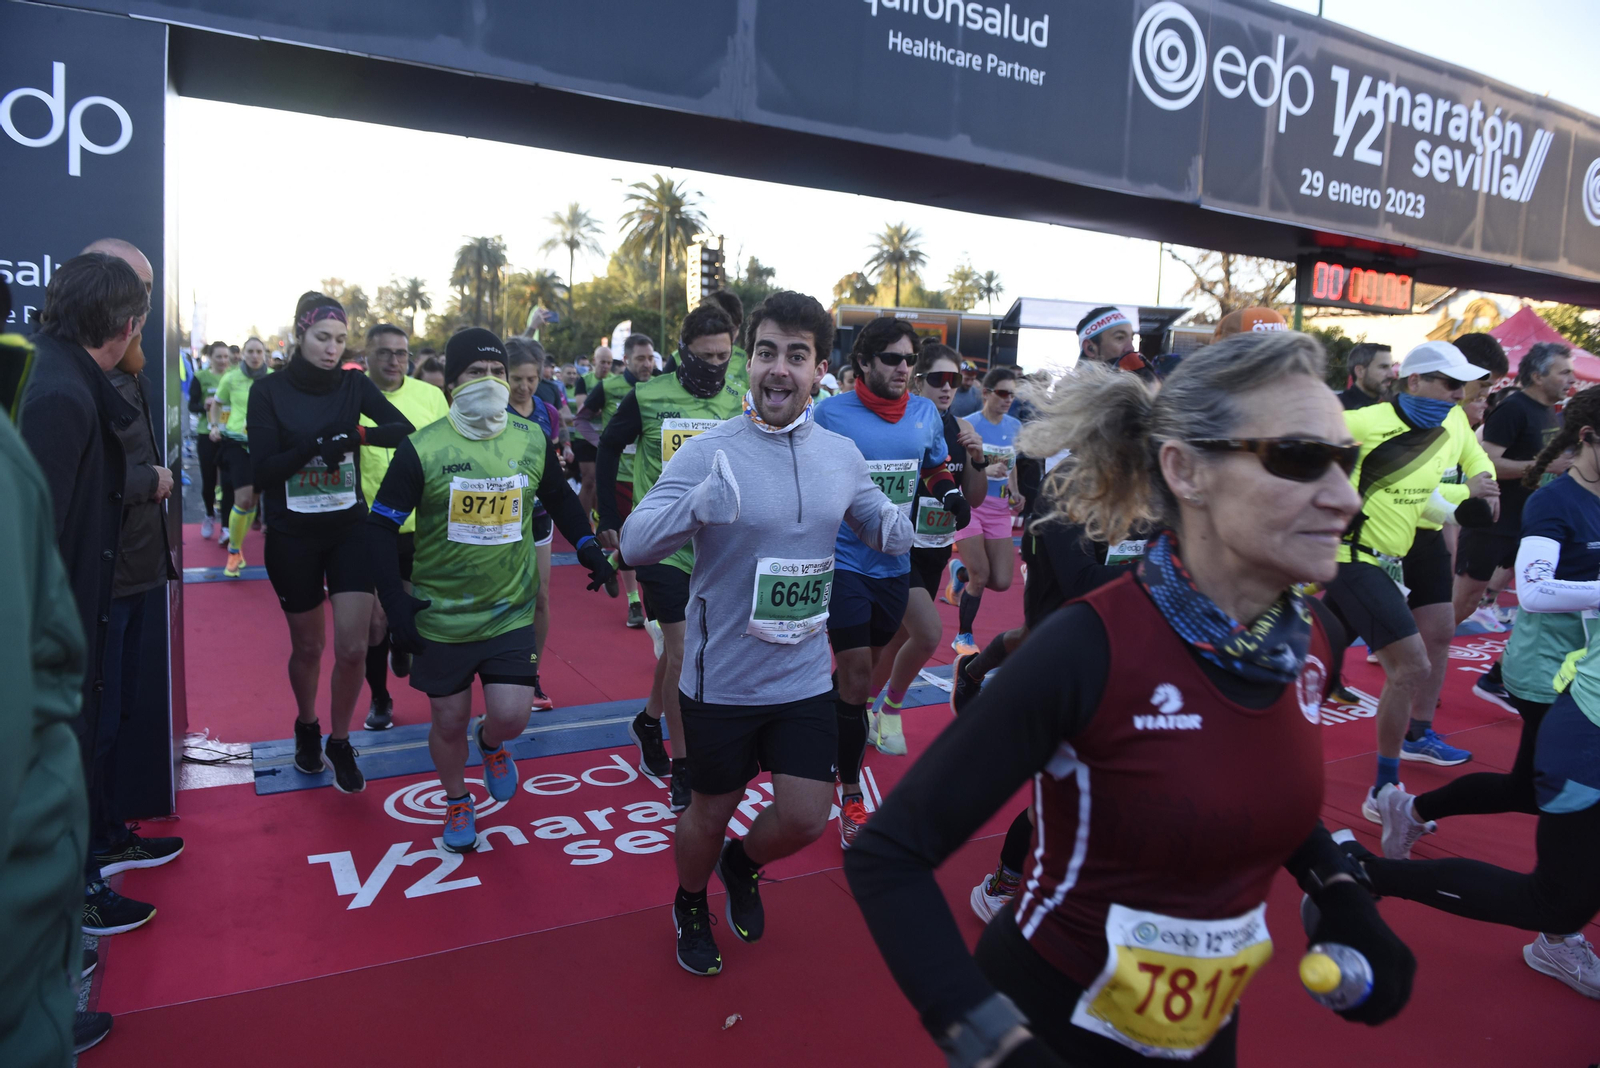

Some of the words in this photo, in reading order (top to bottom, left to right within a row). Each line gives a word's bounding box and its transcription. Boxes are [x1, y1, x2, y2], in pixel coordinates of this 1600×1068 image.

[888, 29, 982, 71] Healthcare
[986, 53, 1046, 86] Partner
[1212, 34, 1315, 133] edp
[1377, 79, 1523, 159] maratón
[1412, 139, 1522, 201] sevilla
[1300, 168, 1325, 197] 29
[1328, 178, 1382, 210] enero
[1384, 187, 1426, 219] 2023
[512, 420, 529, 431] 2023
[656, 411, 681, 419] HOKA
[442, 462, 472, 475] HOKA
[945, 462, 964, 472] ore
[297, 469, 341, 488] 7018
[870, 474, 906, 495] 374
[462, 494, 508, 515] 9717
[926, 510, 955, 527] 672
[781, 563, 799, 575] edp
[770, 579, 823, 608] 6645
[1132, 713, 1203, 731] VIATOR
[1133, 963, 1250, 1023] 7817
